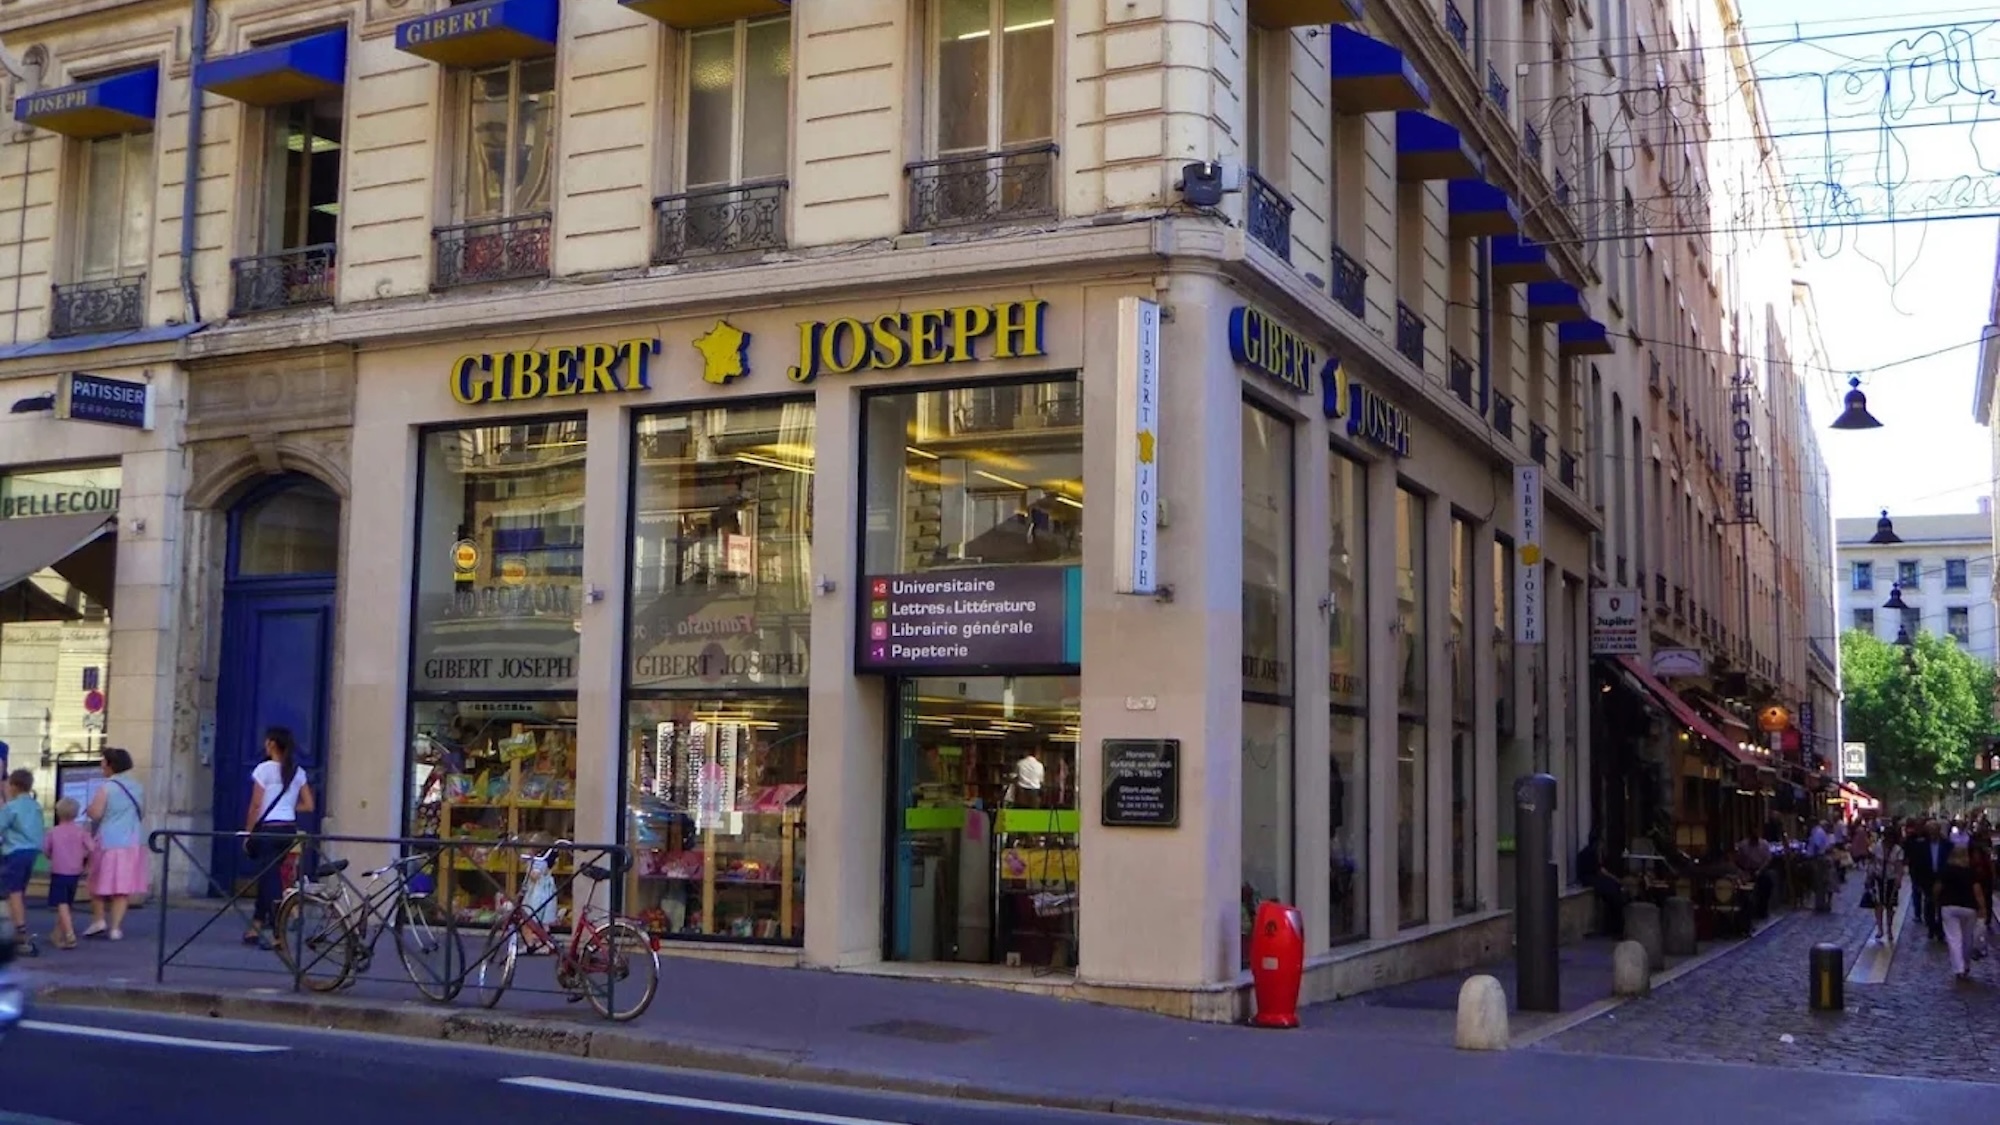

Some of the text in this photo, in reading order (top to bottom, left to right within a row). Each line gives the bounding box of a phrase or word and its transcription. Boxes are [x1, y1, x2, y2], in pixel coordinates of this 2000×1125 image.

[406, 8, 492, 44] GIBERT
[26, 89, 87, 117] JOSEPH
[450, 300, 1048, 404] GIBERT JOSEPH
[73, 380, 144, 405] PATISSIER
[1242, 305, 1412, 460] GIBERT JOSEPH
[1139, 310, 1152, 586] GIBERT JOSEPH
[1732, 393, 1754, 518] HOTEL
[1523, 470, 1534, 640] GIBERT JOSEPH
[892, 578, 995, 594] Universitaire
[892, 602, 945, 616] Lettres
[954, 600, 1036, 614] Littérature
[891, 622, 957, 637] Librairie
[962, 620, 1033, 638] générale
[891, 643, 968, 660] Papeterie
[424, 656, 573, 680] GIBERT JOSEPH
[635, 653, 804, 677] GIBERT JOSEPH
